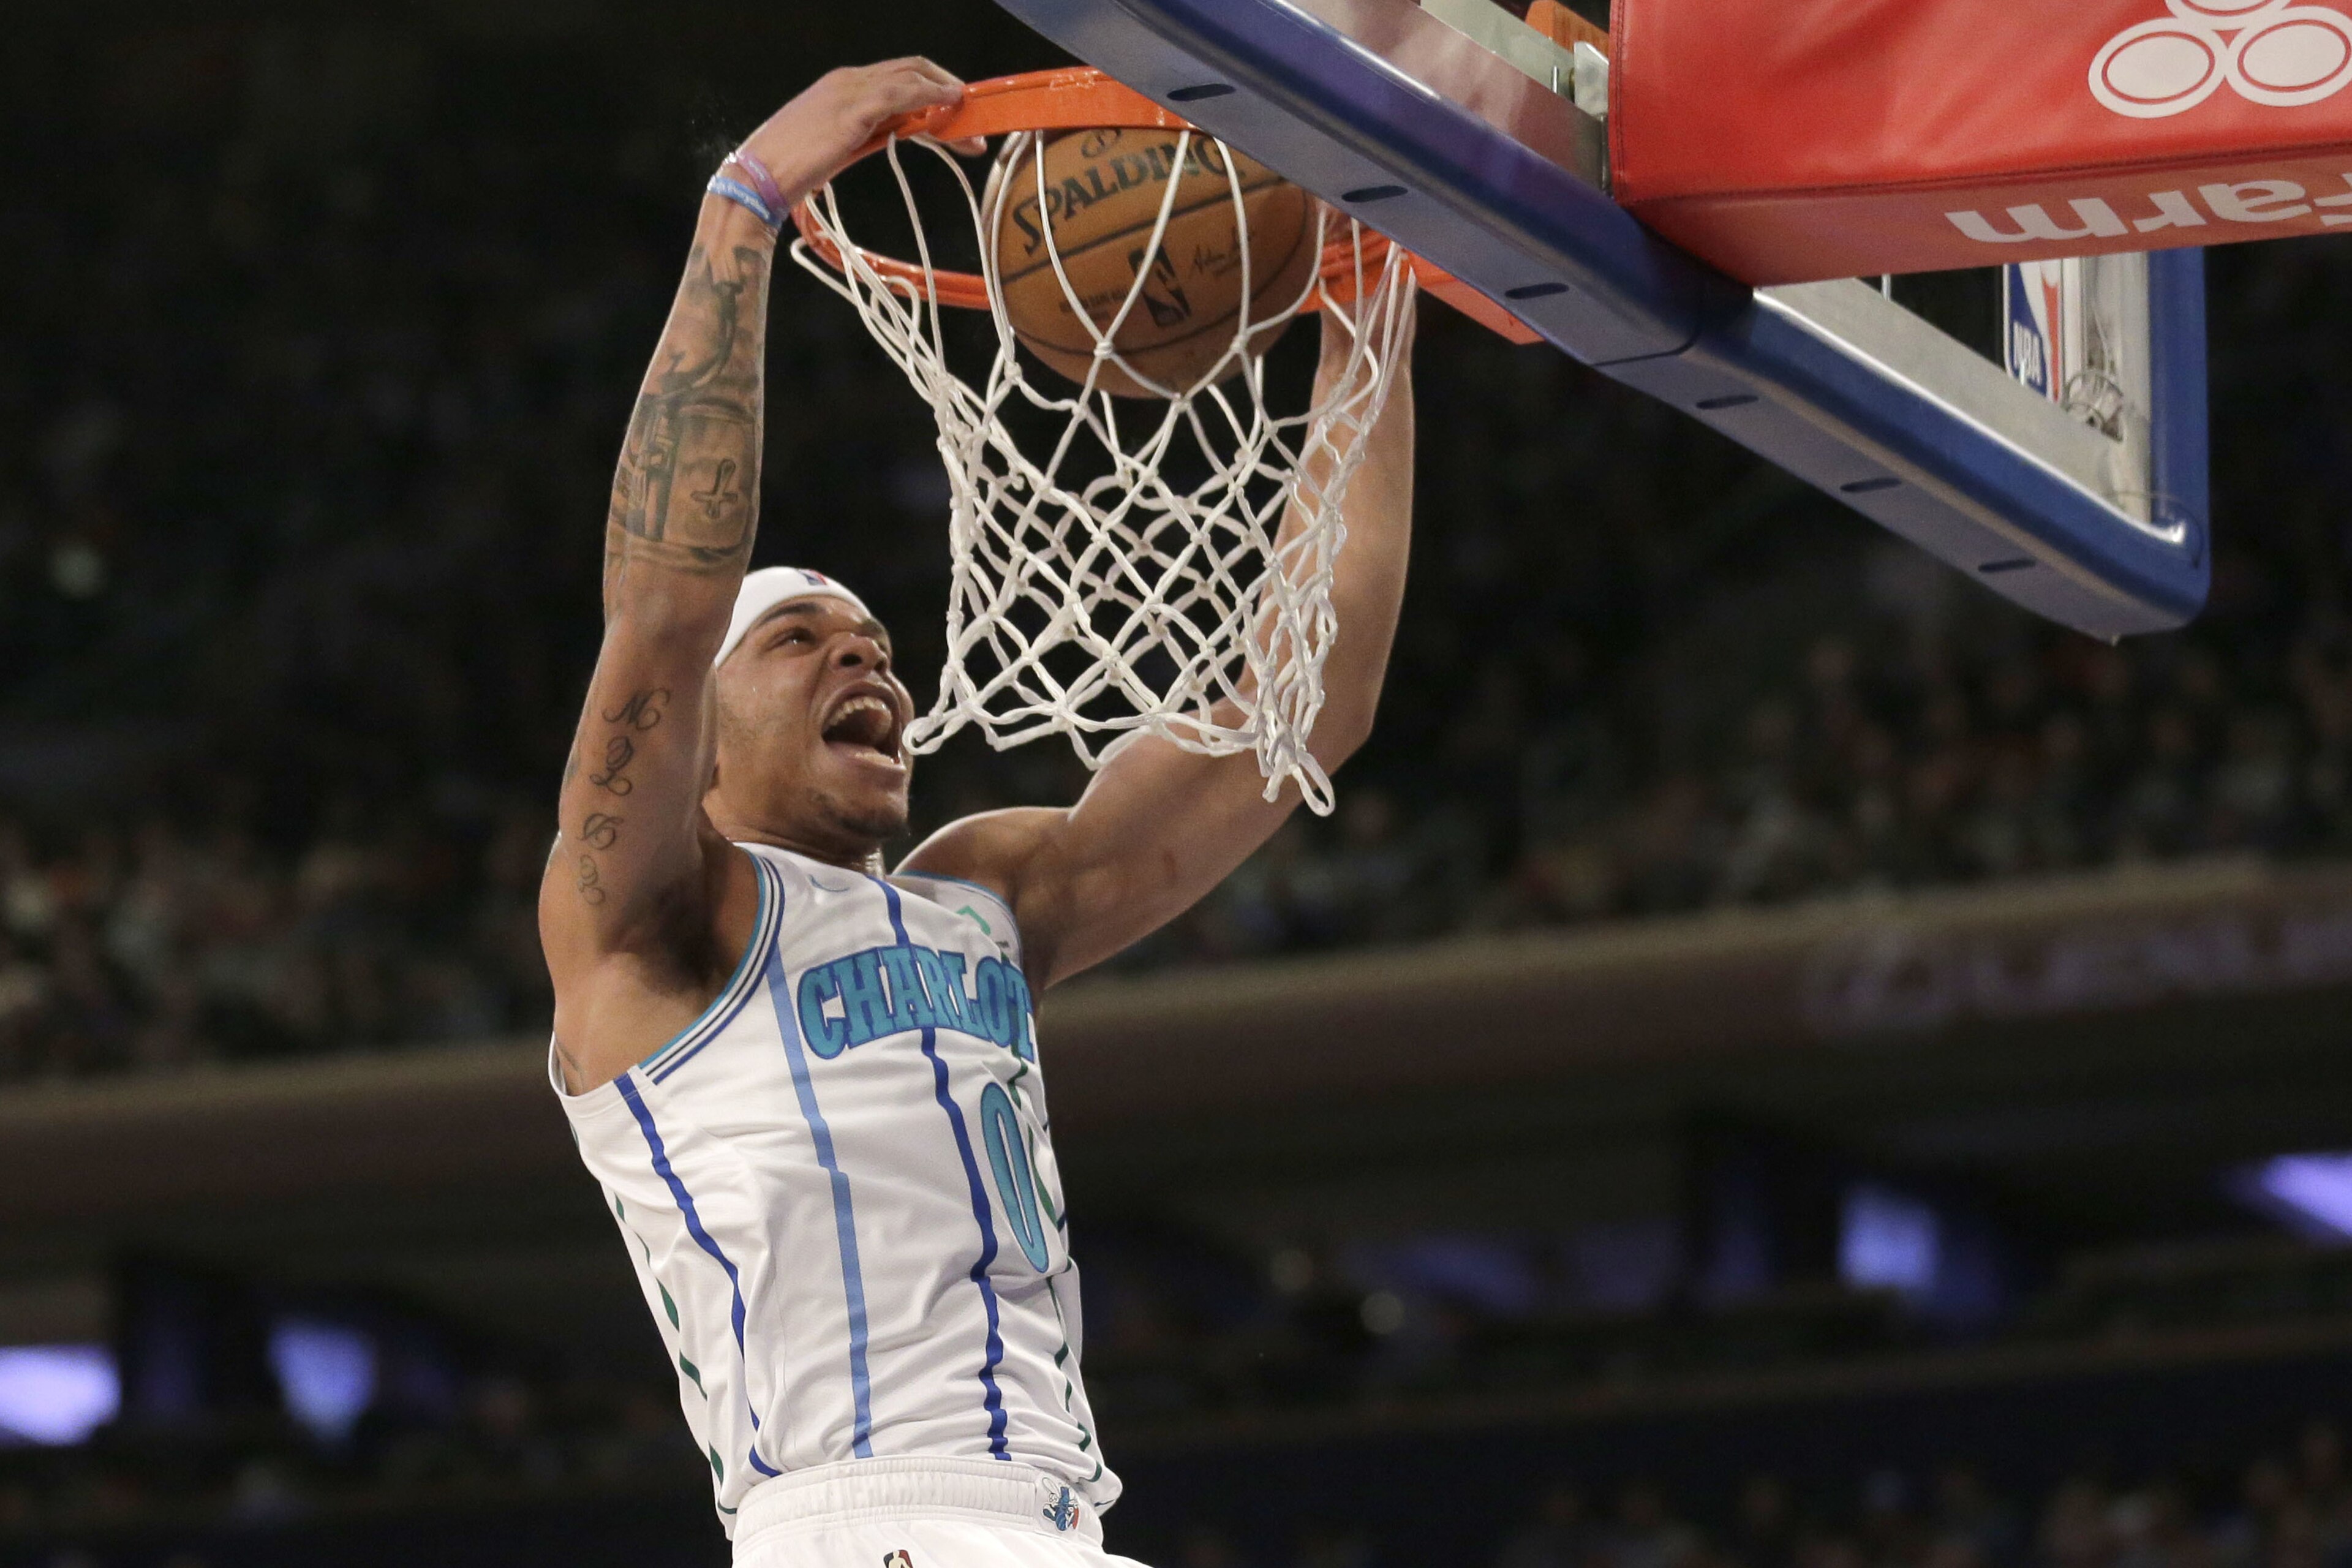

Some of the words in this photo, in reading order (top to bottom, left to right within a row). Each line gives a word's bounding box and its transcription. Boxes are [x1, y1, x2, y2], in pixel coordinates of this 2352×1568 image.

[1012, 136, 1245, 255] SPALDING
[2012, 321, 2043, 387] NBA
[980, 1082, 1049, 1273] 0
